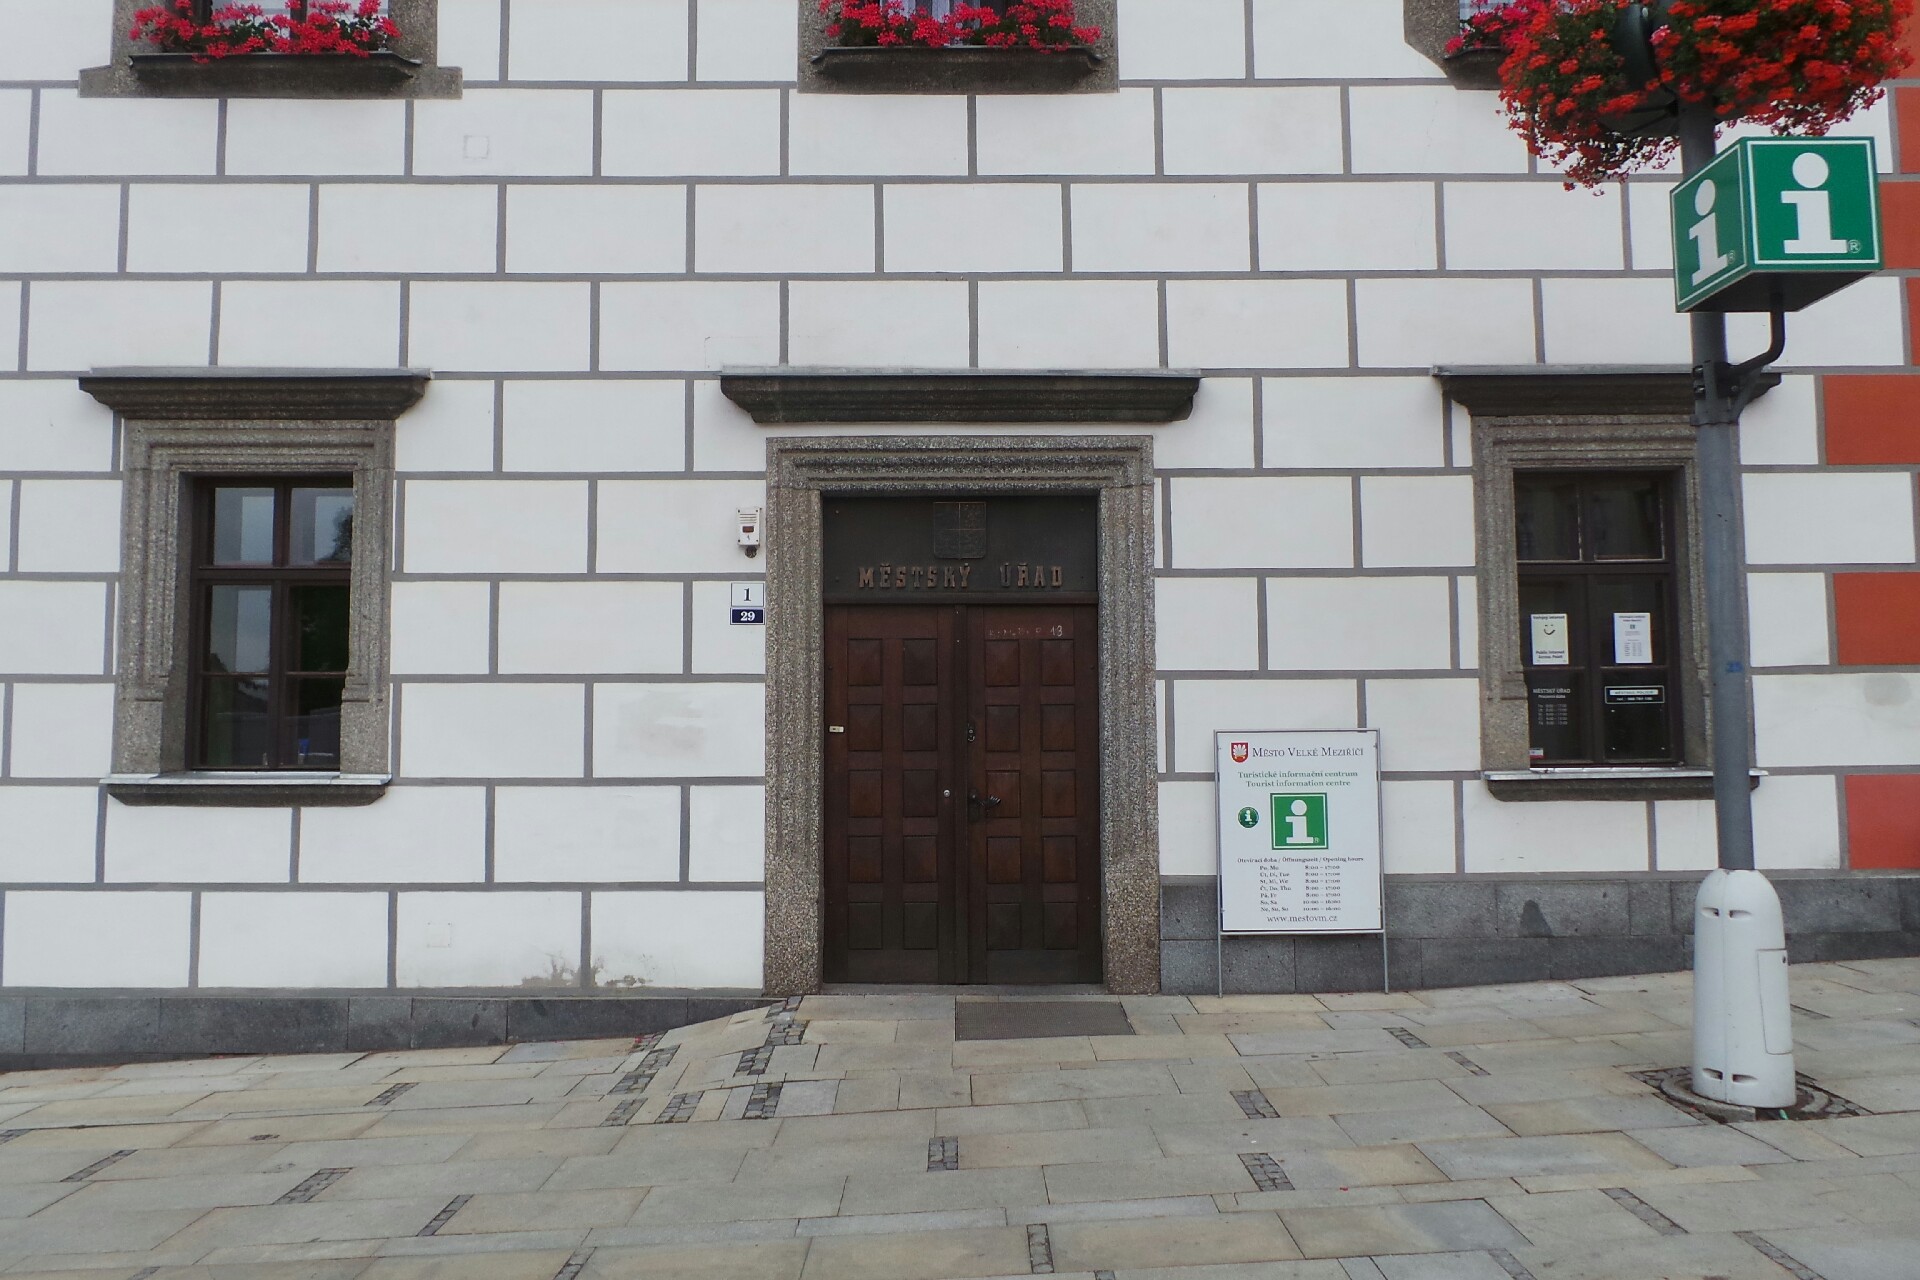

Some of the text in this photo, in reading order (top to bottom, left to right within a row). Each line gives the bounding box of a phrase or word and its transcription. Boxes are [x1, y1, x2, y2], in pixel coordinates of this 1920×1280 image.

[858, 562, 1063, 588] MĚSTSKÝ ÚŘAD
[744, 588, 752, 602] 1
[740, 610, 756, 622] 29
